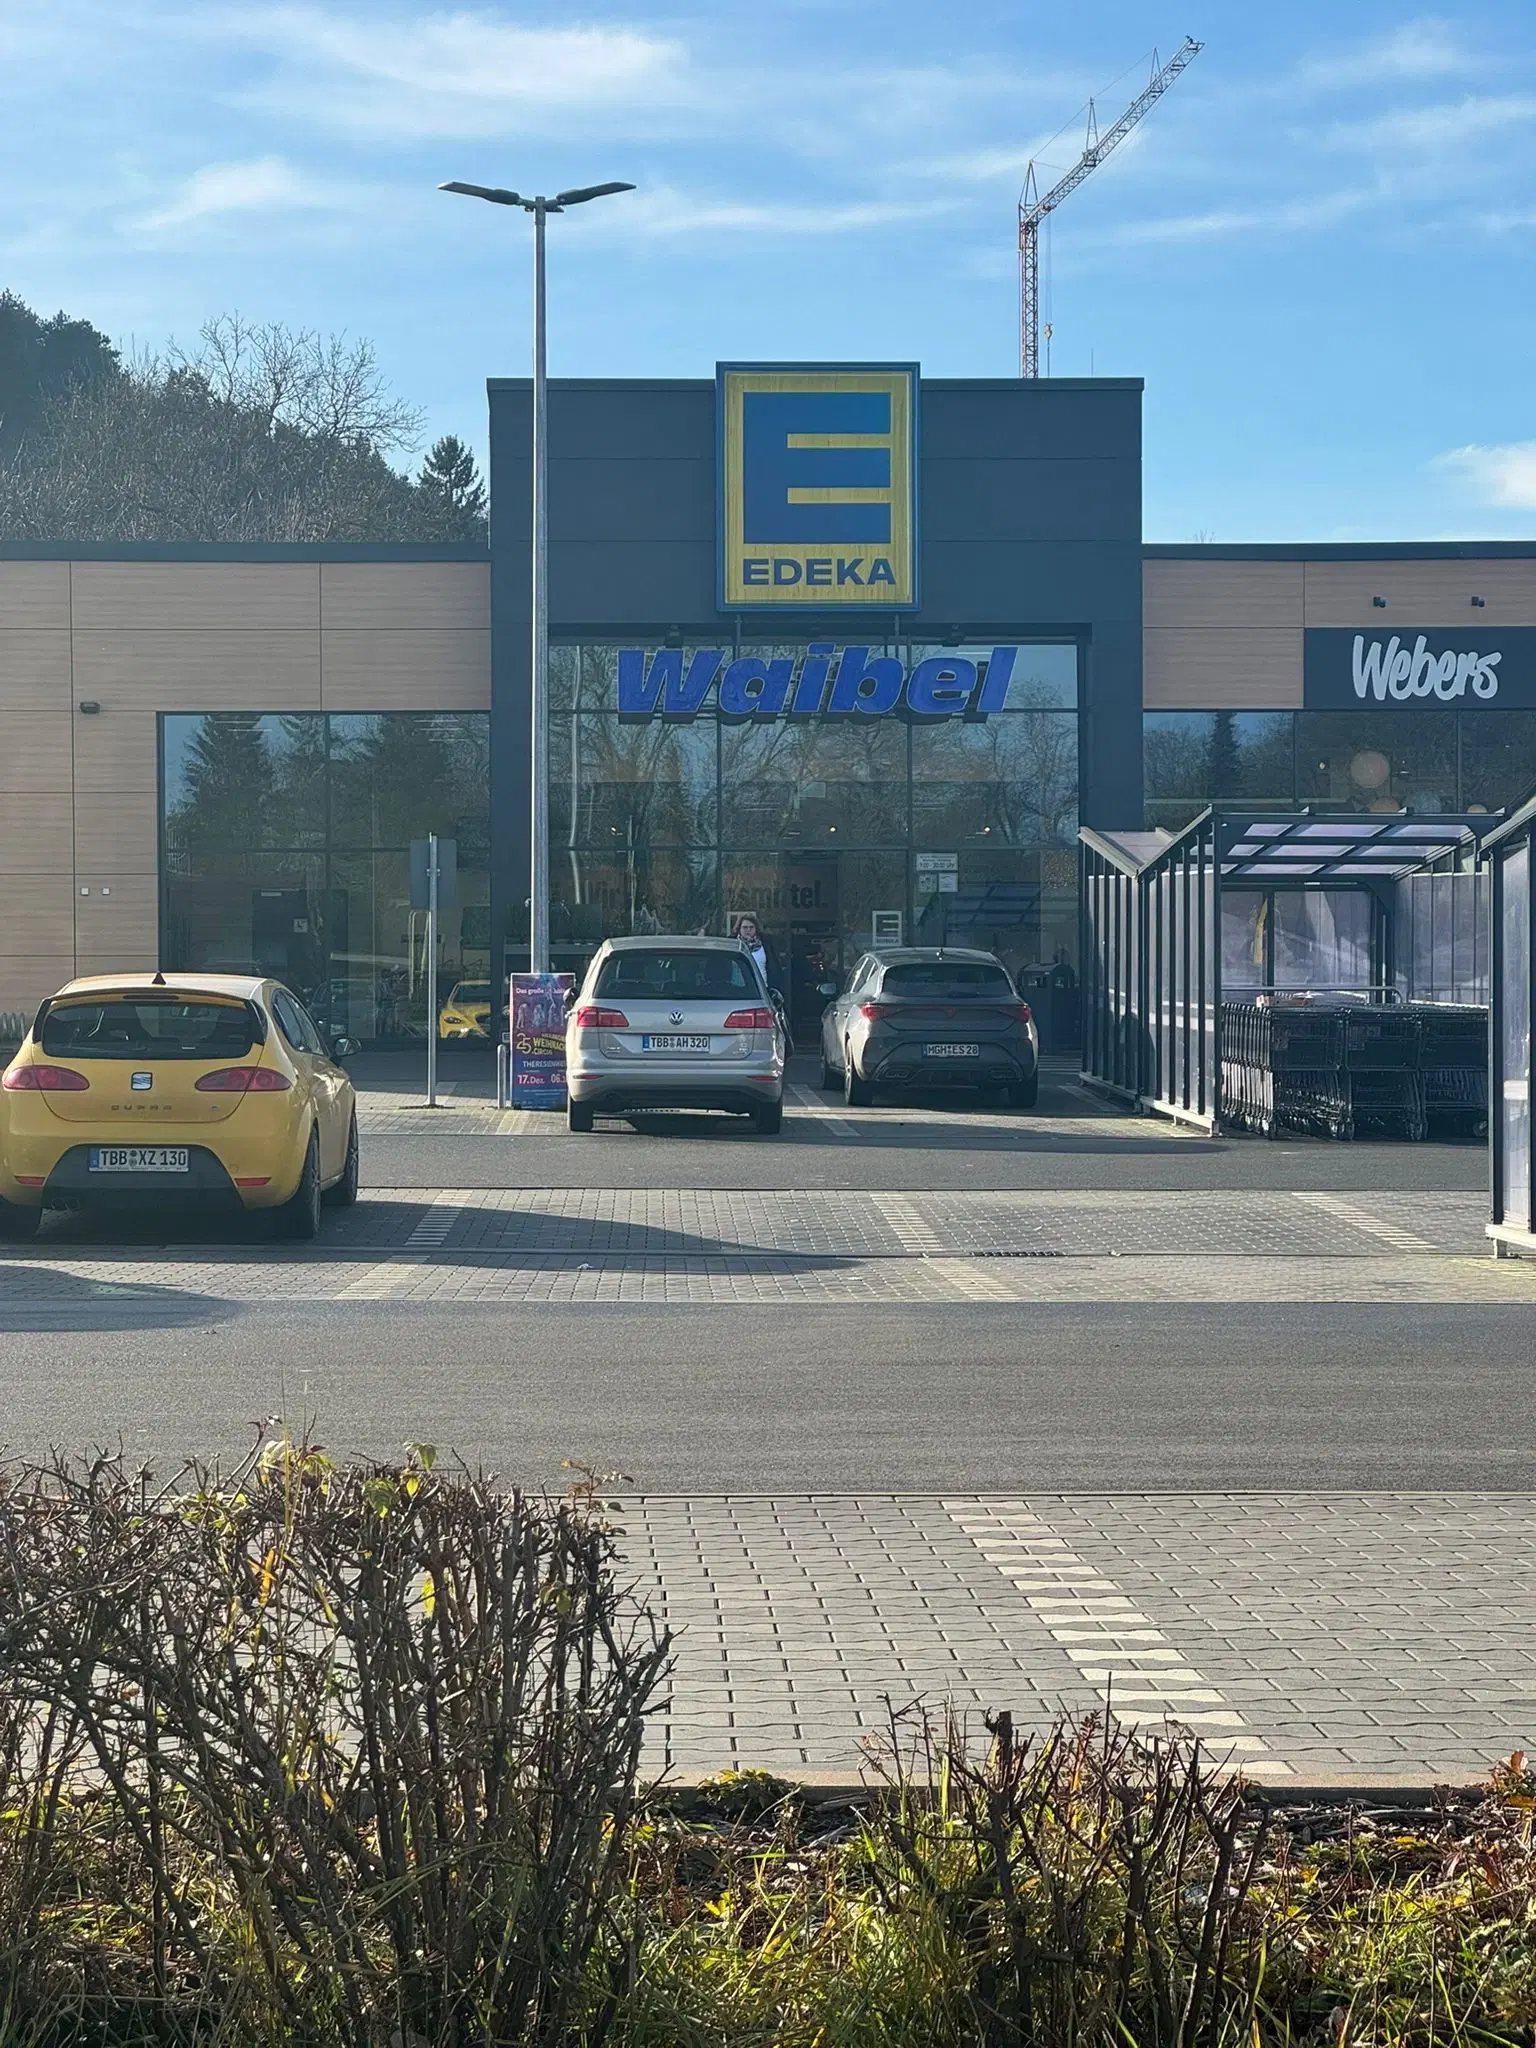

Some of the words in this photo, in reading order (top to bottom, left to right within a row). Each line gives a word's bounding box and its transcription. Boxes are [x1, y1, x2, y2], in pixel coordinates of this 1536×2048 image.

[743, 558, 896, 586] EDEKA
[1352, 635, 1502, 700] Webers
[617, 643, 1019, 714] Waibel
[651, 1037, 670, 1048] TBB
[676, 1037, 689, 1048] AH
[690, 1037, 708, 1048] 320
[928, 1045, 947, 1054] MGH
[101, 1151, 127, 1166] TBB
[138, 1151, 157, 1166] XZ
[160, 1151, 186, 1166] 130
